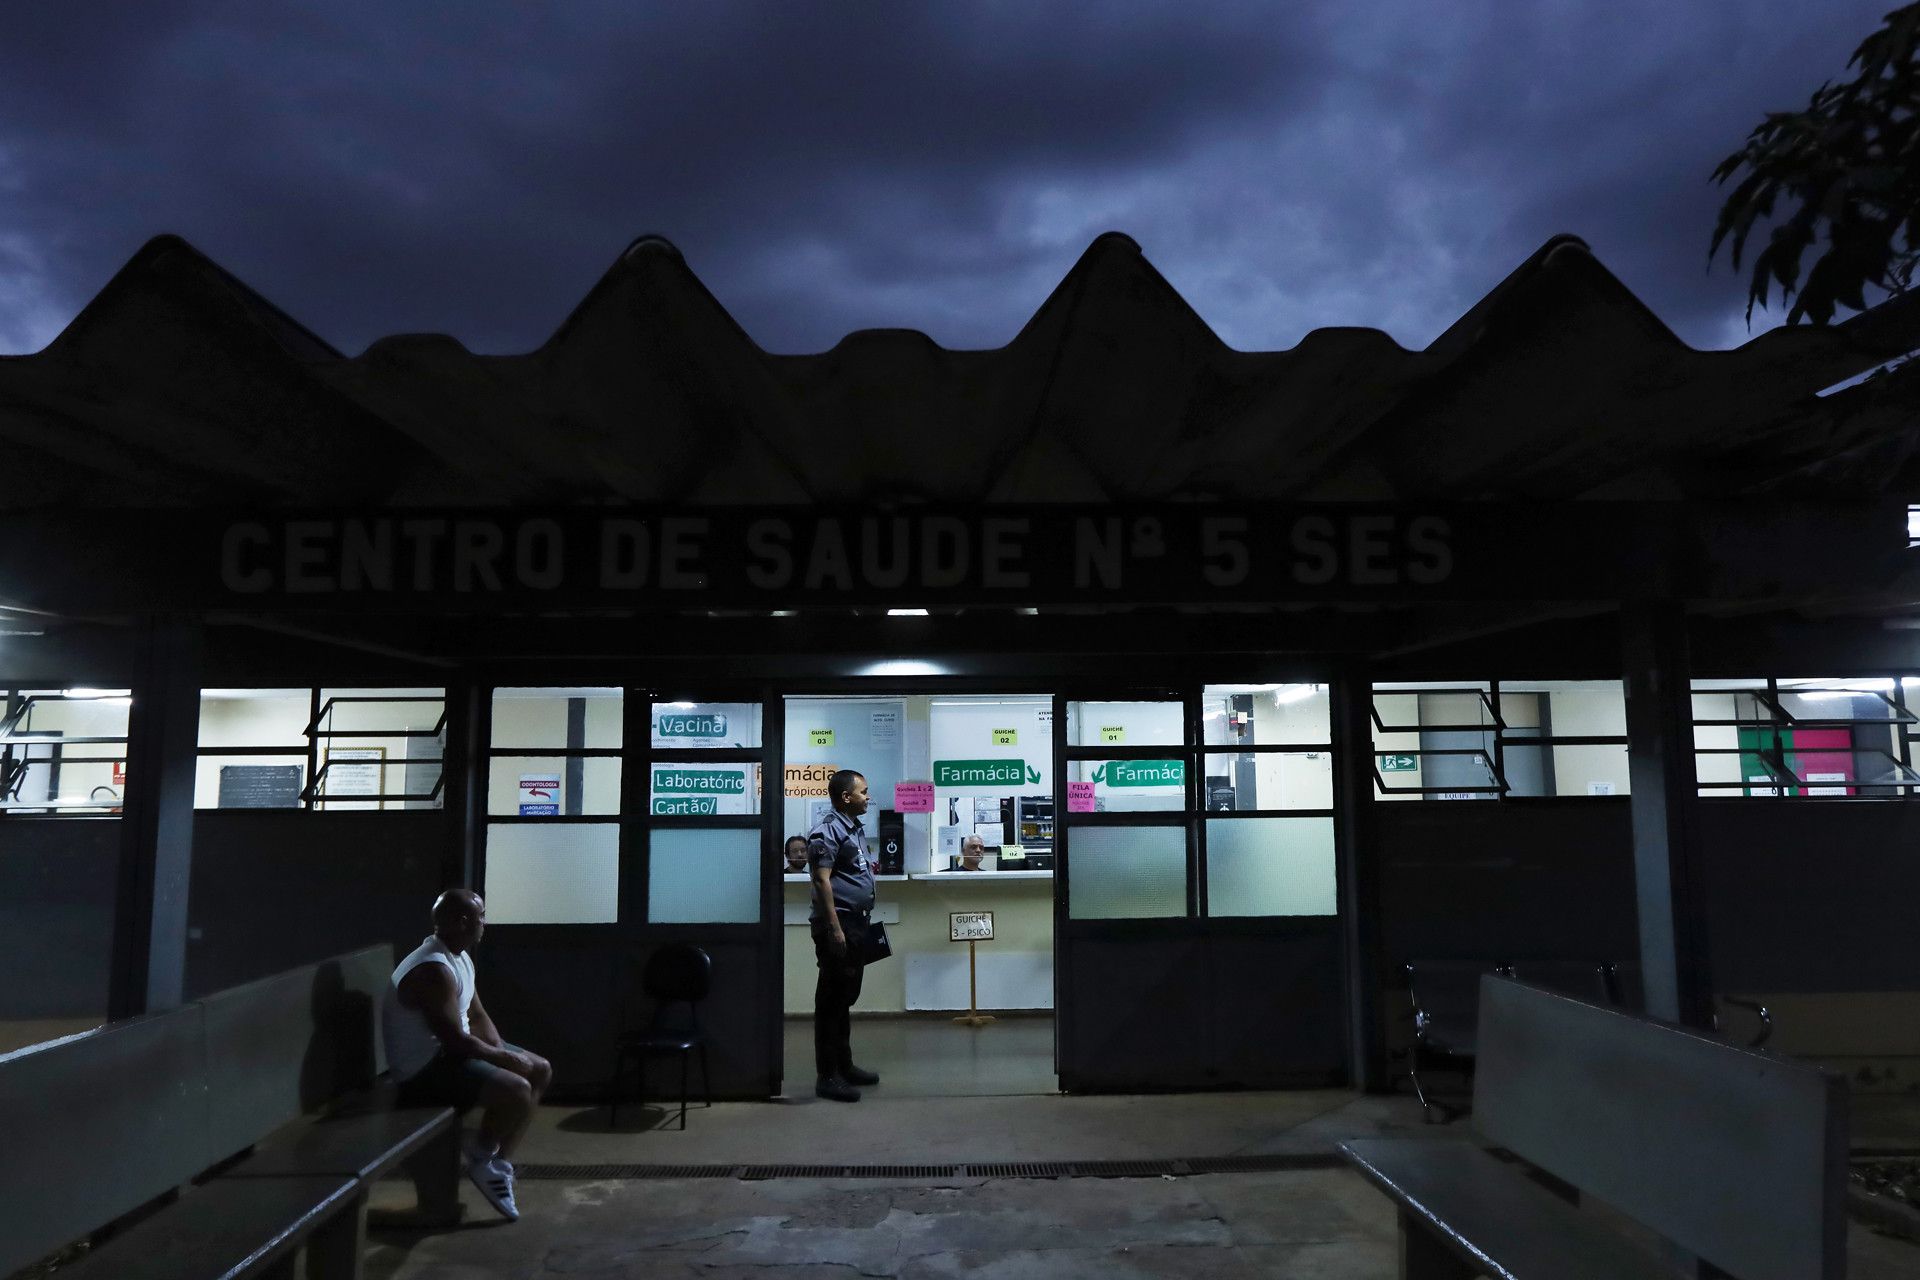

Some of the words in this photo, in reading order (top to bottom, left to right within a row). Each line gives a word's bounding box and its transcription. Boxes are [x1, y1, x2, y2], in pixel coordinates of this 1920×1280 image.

[220, 518, 564, 593] CENTRO
[600, 517, 709, 590] DE
[1202, 516, 1250, 587] 5
[1289, 516, 1455, 585] SES
[661, 716, 723, 733] Vacina
[656, 774, 744, 789] Laboratório
[941, 765, 1020, 782] Farmácia
[953, 928, 959, 937] 3
[967, 928, 991, 937] PSICO
